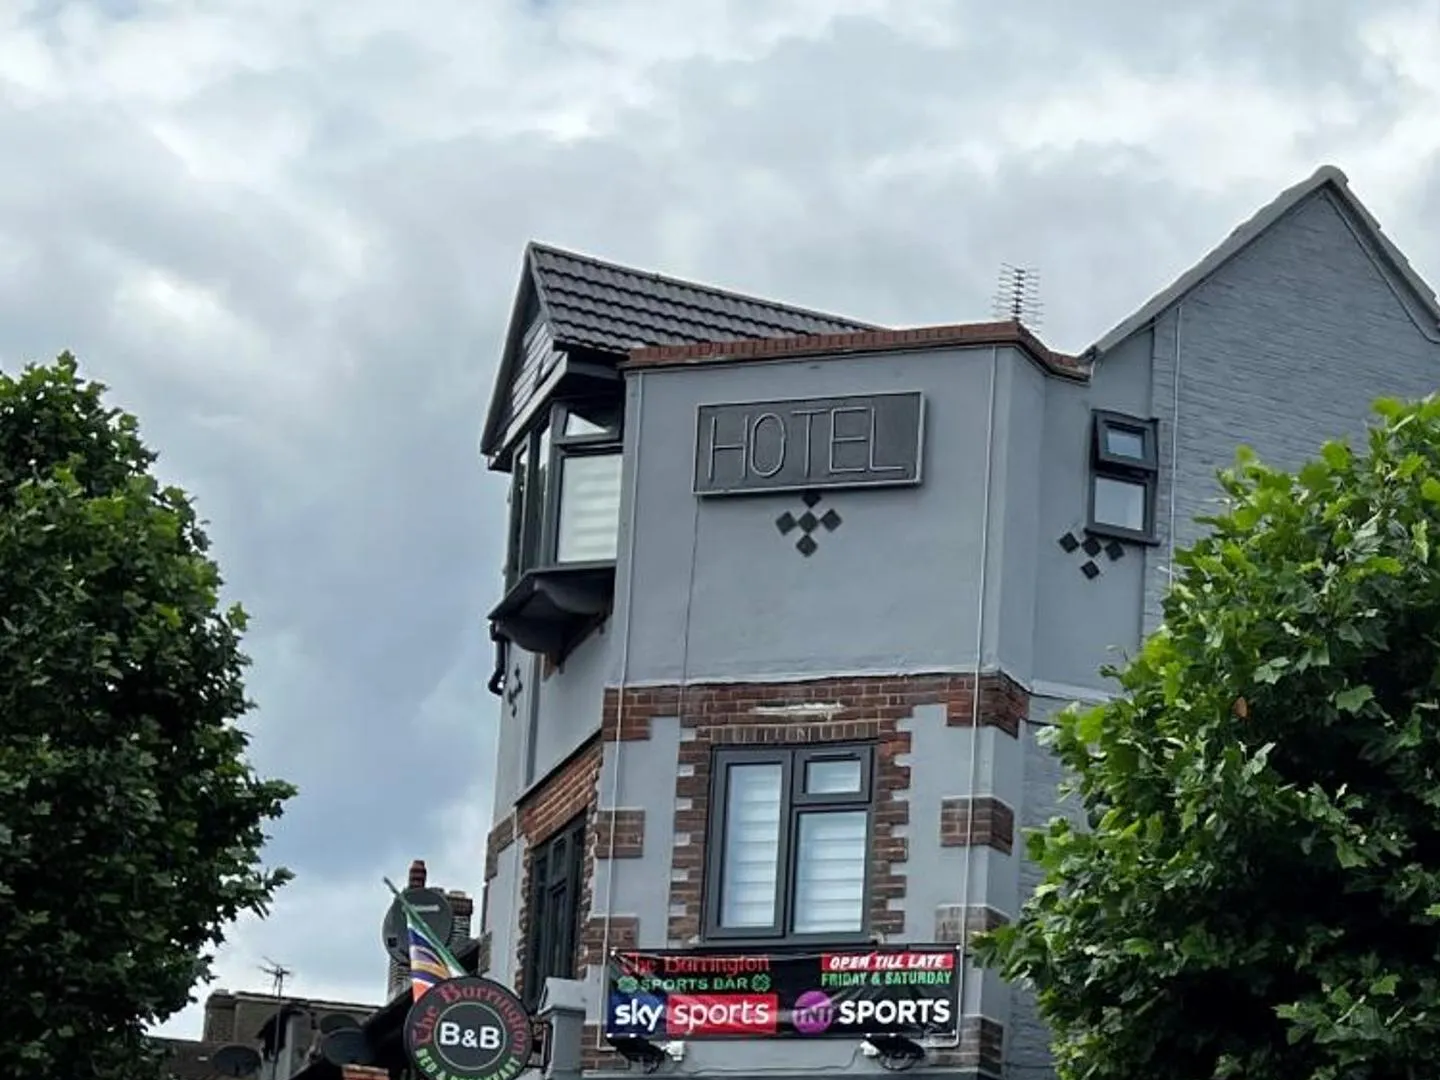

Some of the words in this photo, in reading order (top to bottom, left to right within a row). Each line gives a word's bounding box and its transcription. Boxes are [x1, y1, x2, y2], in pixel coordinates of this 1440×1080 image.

[706, 404, 906, 482] HOTEL
[664, 954, 771, 976] Barrington
[829, 955, 870, 970] OPEN
[875, 954, 906, 969] TILL
[908, 953, 945, 968] LATE
[640, 977, 709, 992] SPORTS
[713, 976, 749, 991] BAR
[821, 972, 867, 987] FRIDAY
[885, 971, 952, 986] SATURDAY
[615, 999, 664, 1032] sky
[673, 1000, 770, 1035] sports
[838, 999, 951, 1025] SPORTS
[440, 1021, 500, 1050] B&B
